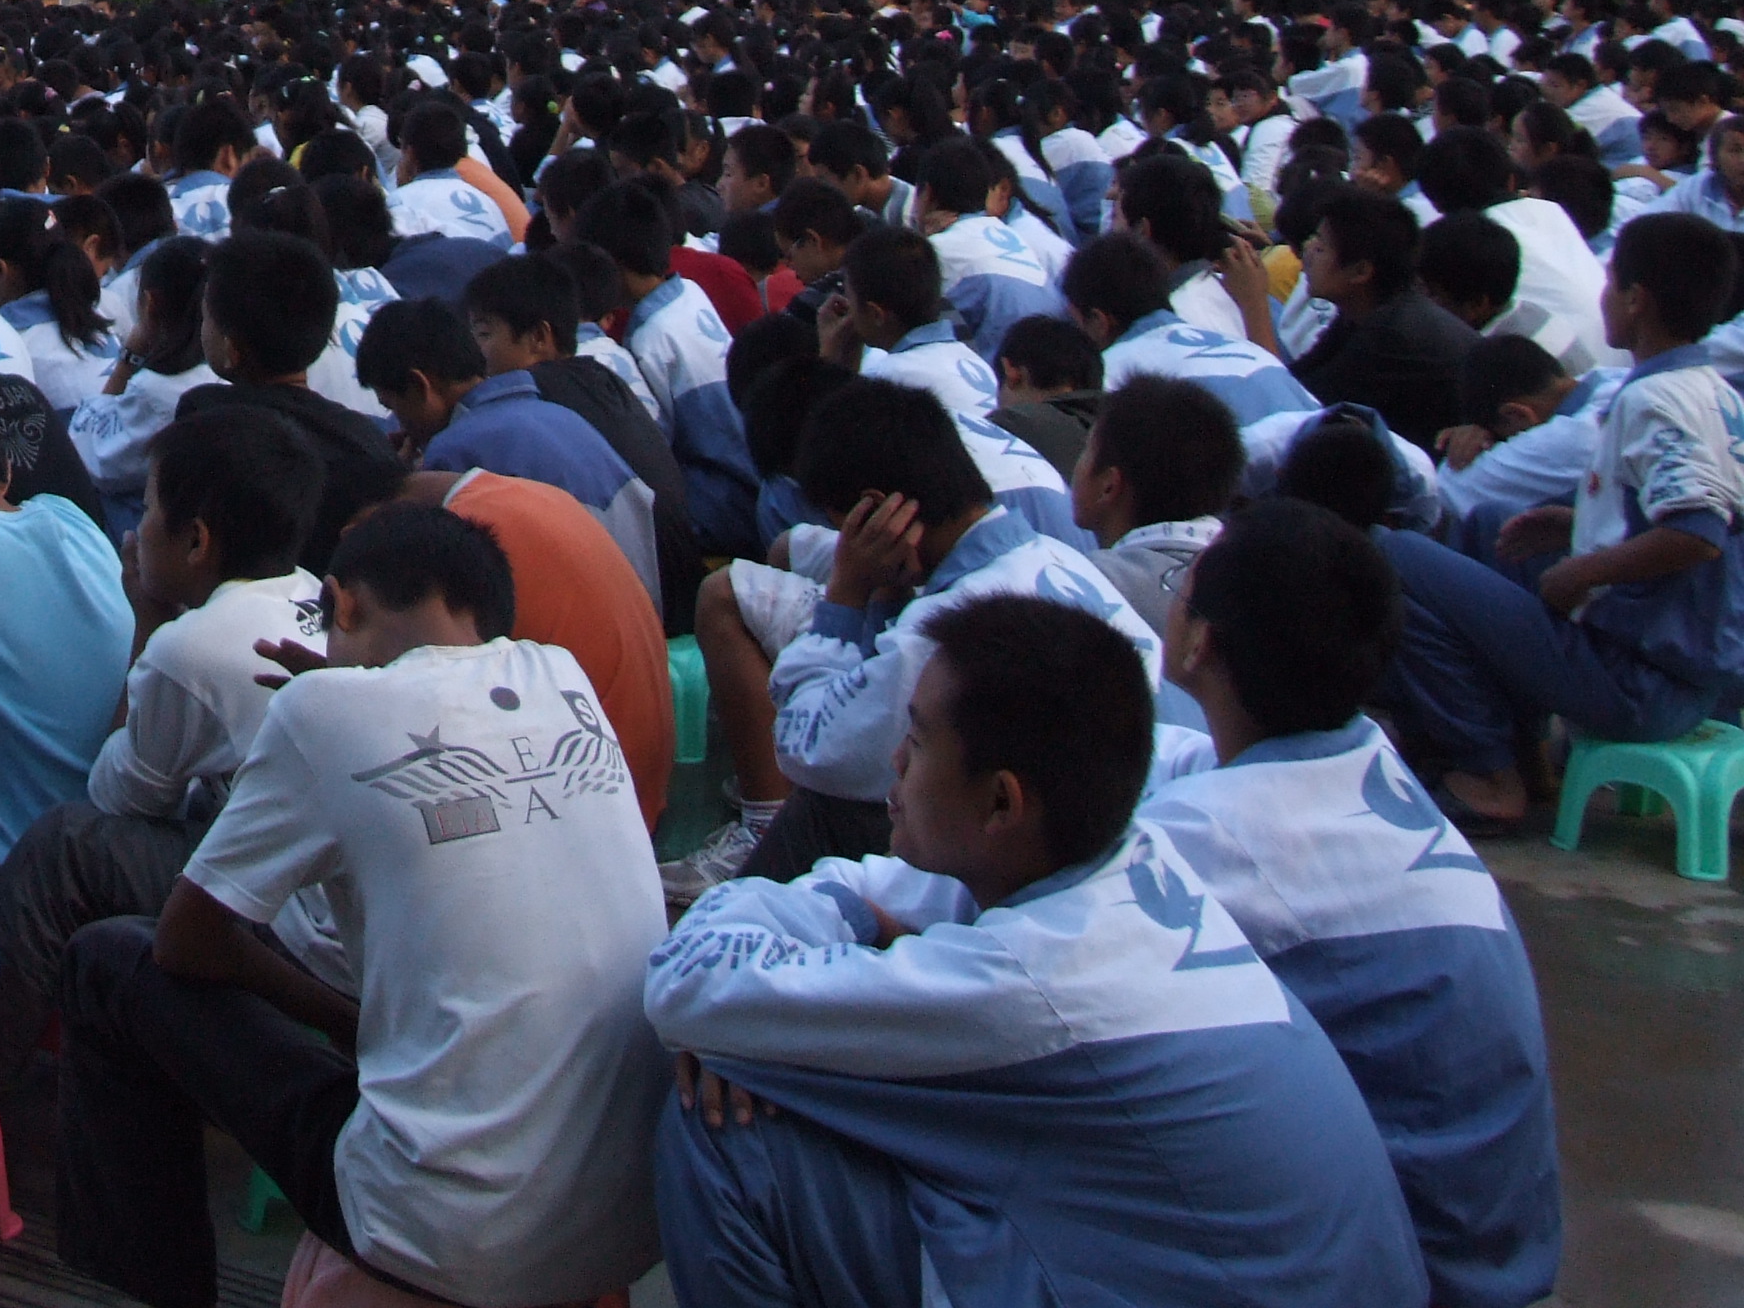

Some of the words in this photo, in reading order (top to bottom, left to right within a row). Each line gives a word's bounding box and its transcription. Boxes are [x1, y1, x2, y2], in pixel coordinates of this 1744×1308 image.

[573, 697, 598, 726] S
[511, 735, 541, 773] E
[524, 784, 561, 825] A
